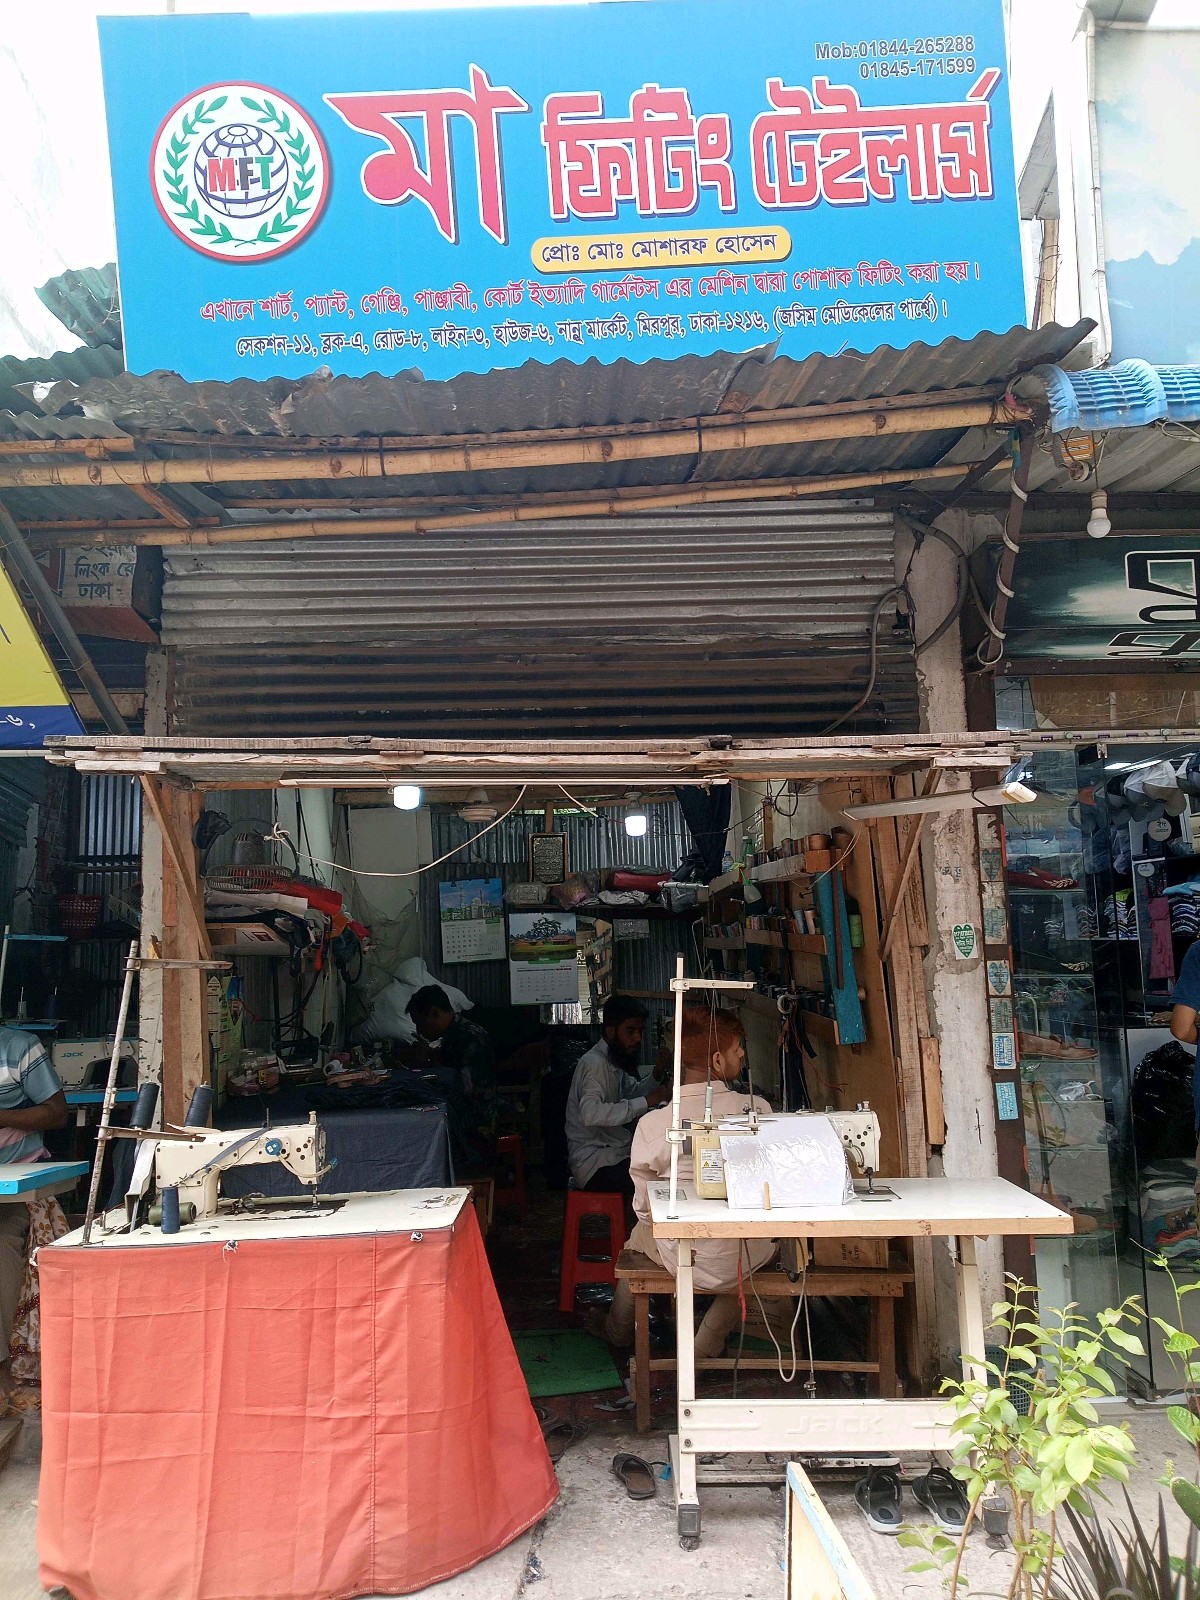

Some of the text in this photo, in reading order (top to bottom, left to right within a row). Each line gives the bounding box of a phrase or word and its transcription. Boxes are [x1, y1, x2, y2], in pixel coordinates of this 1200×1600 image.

[815, 36, 974, 60] Mob:01844-265288
[859, 57, 976, 79] 01845-171599
[323, 62, 1002, 244] মা ফিটিং টেইলার্স
[207, 156, 274, 192] MFT
[588, 240, 624, 260] মোঃ
[631, 237, 708, 258] মোশারফ
[715, 233, 777, 255] হোসেন
[200, 298, 256, 321] এখানে
[259, 289, 298, 322] শার্ট,
[304, 289, 355, 319] প্যান্ট,
[361, 286, 409, 317] গেঞ্জি,
[414, 282, 477, 313] পাঞ্জাবী,
[484, 279, 525, 308] কোর্ট
[528, 276, 587, 307] ইত্যাদি
[591, 274, 659, 303] গার্মেন্টস
[665, 277, 692, 298] এর
[698, 269, 748, 297] মেশিন
[752, 271, 787, 294] দ্বারা
[793, 267, 852, 290] পোশাক
[857, 259, 904, 287] ফিটিং
[906, 261, 940, 284] করা
[585, 312, 633, 341] মার্কেট,
[635, 310, 686, 339] মিরপুর,
[821, 298, 896, 325] মেডিকেলের
[74, 555, 110, 581] লিংক
[77, 582, 113, 600] ঢাকা
